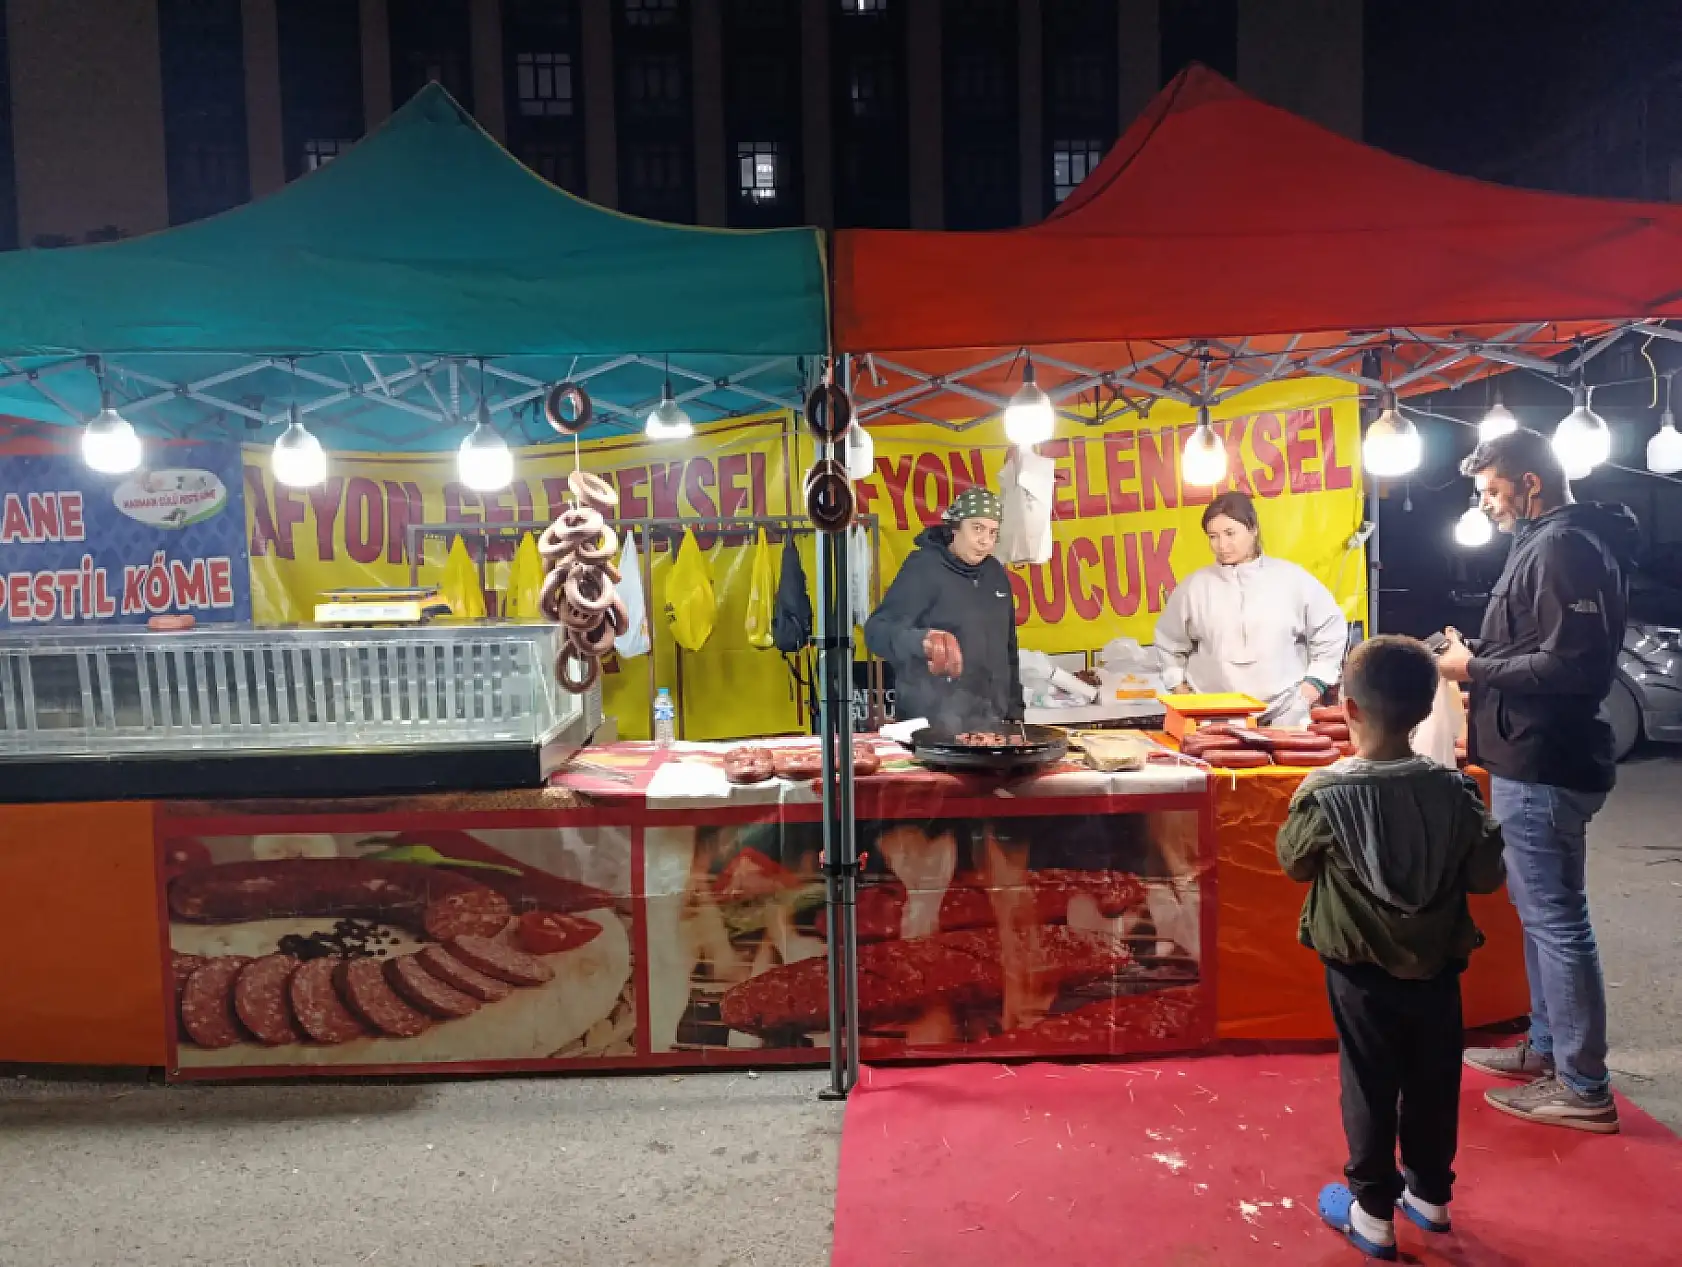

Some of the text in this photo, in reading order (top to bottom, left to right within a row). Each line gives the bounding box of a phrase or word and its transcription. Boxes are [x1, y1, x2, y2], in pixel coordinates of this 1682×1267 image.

[244, 452, 784, 566] AFYON GELEKSEL
[855, 406, 1353, 530] FYON ELENKSEL
[121, 550, 234, 615] KÖME
